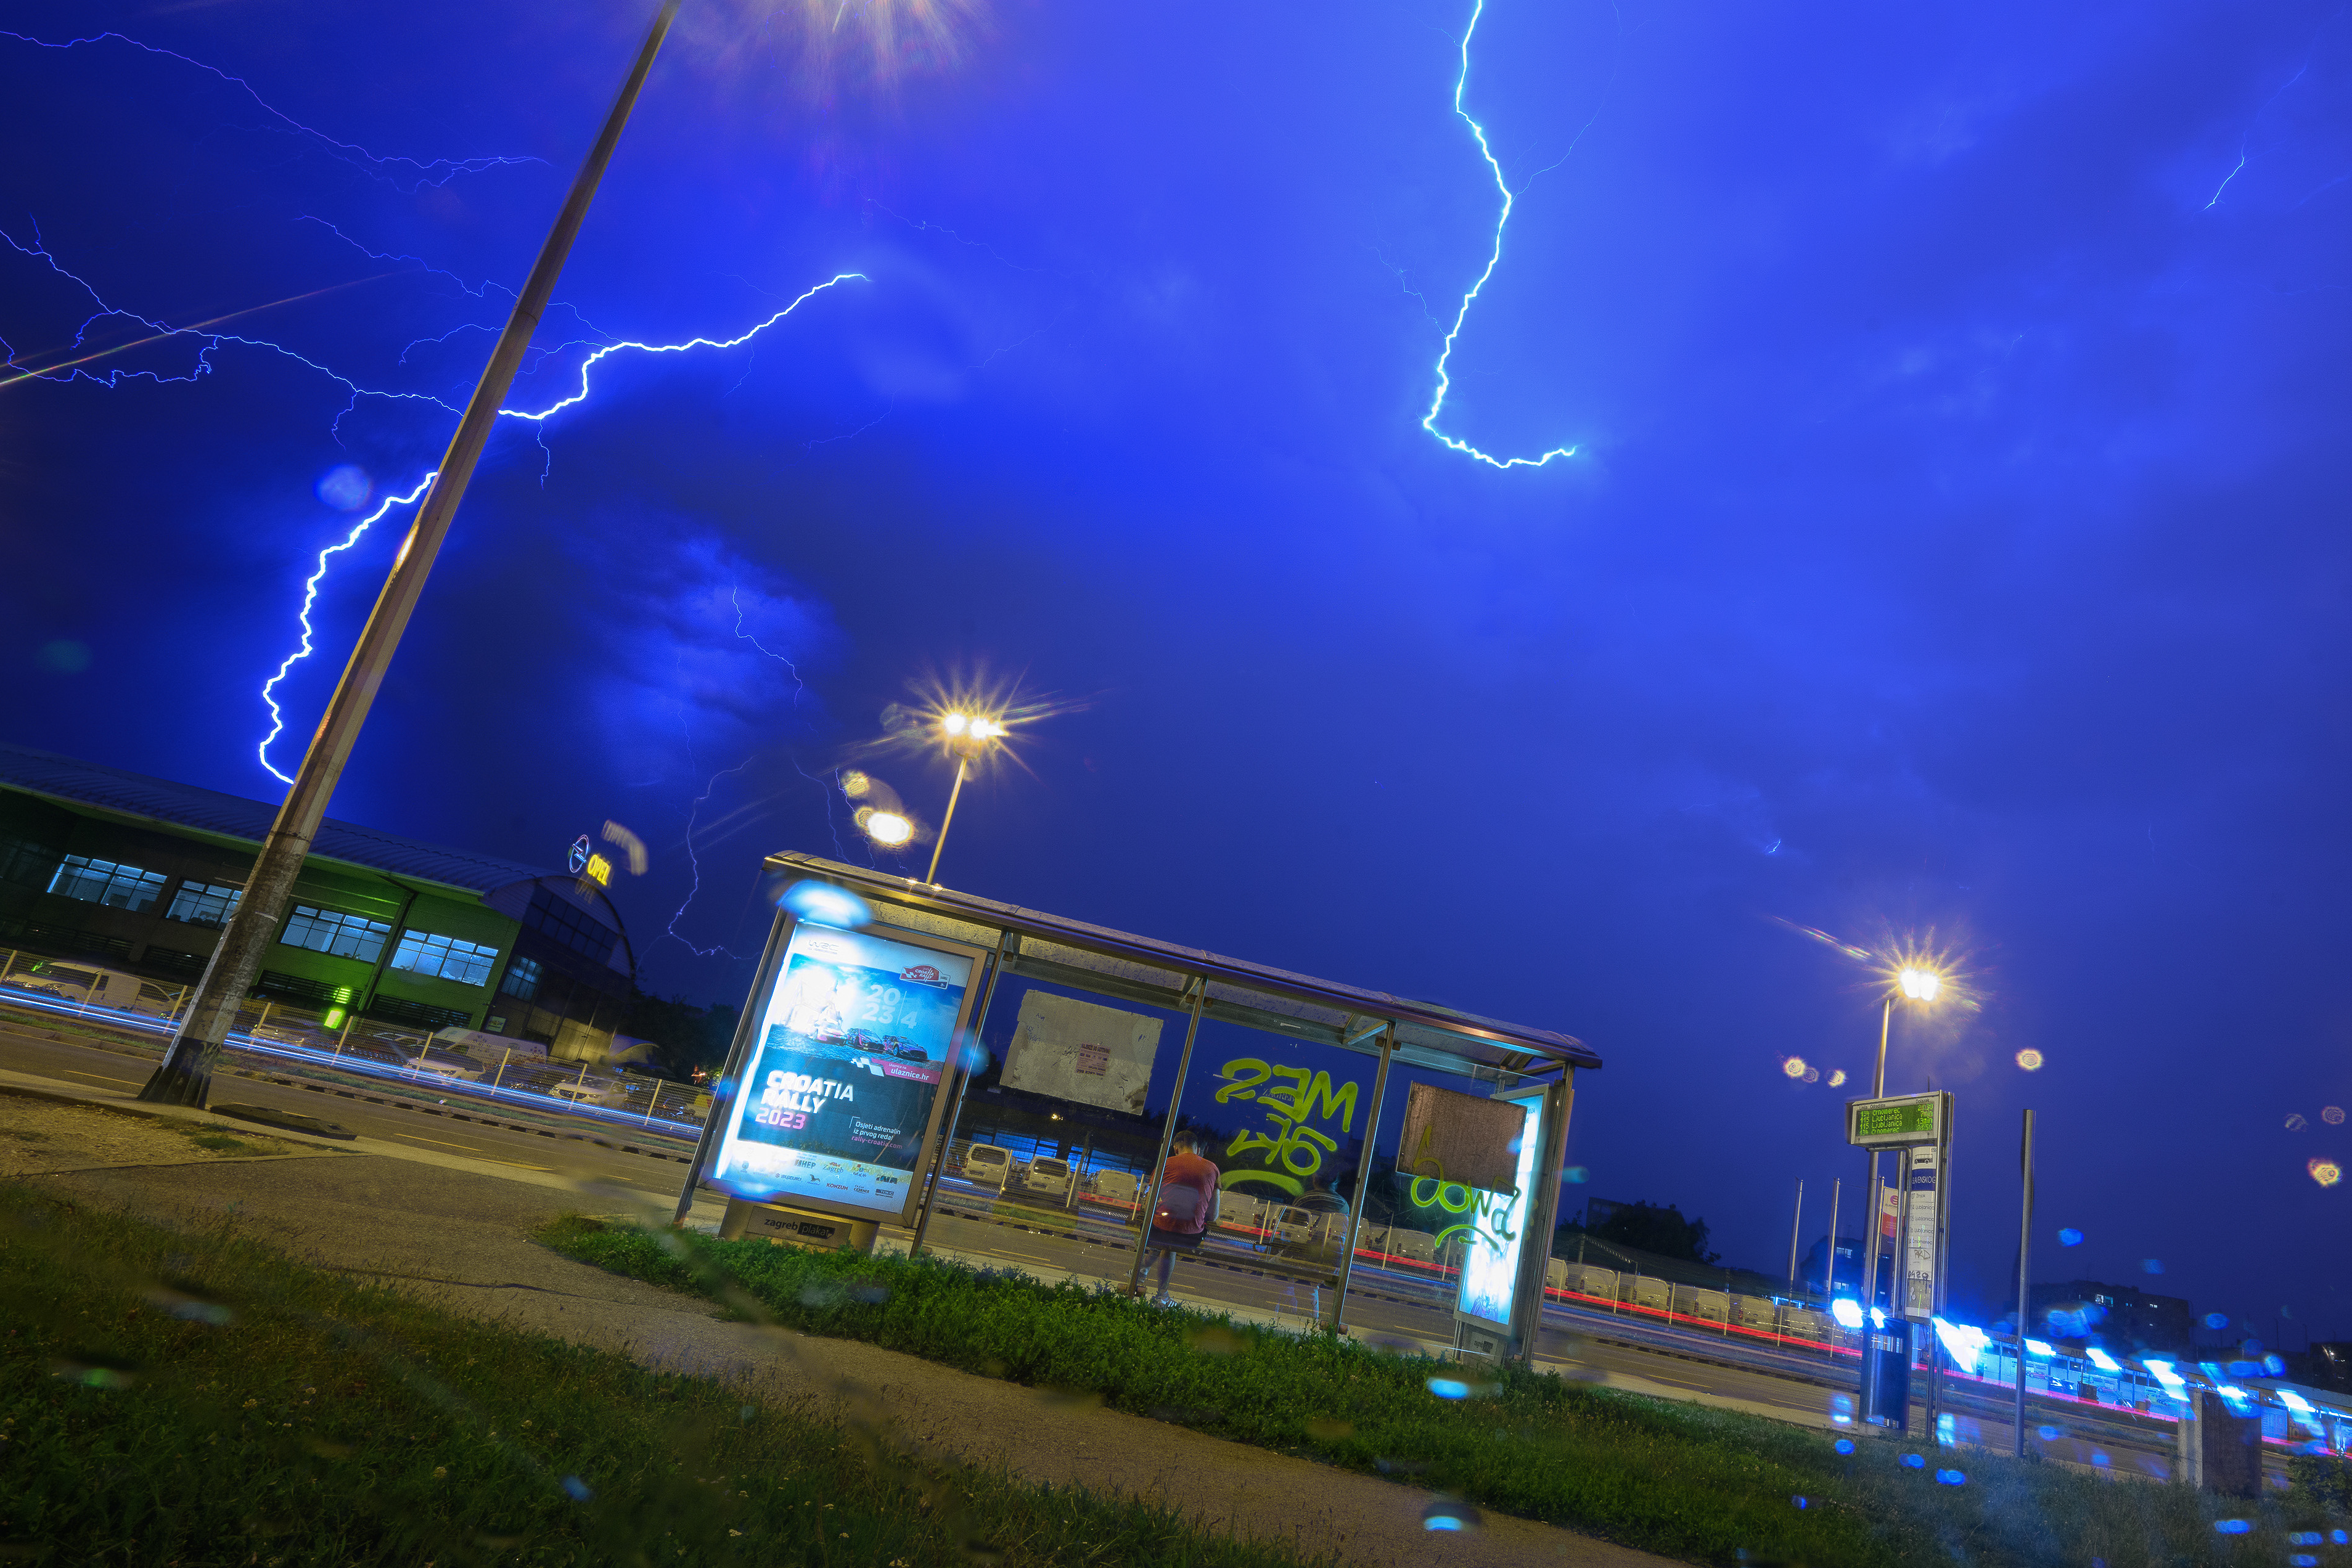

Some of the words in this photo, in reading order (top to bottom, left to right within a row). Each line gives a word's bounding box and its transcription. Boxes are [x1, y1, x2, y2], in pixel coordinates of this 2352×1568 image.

[588, 854, 610, 886] OPEL
[867, 984, 901, 1006] 20
[863, 1002, 896, 1024] 23
[900, 1011, 917, 1029] 4
[891, 1068, 929, 1081] ulaznice.hr
[766, 1070, 854, 1101] CROATIA
[760, 1088, 826, 1114] RALLY
[1263, 1088, 1295, 1102] ZAGREB
[755, 1107, 806, 1130] 2023
[856, 1121, 874, 1130] Osjeti
[874, 1125, 901, 1135] adrenalin
[859, 1130, 877, 1139] prvog
[851, 1136, 903, 1149] rally-croatia.com
[822, 1164, 843, 1174] Zagreb
[826, 1182, 848, 1191] KONZUM
[764, 1219, 798, 1230] zagreb
[801, 1225, 831, 1238] plakat
